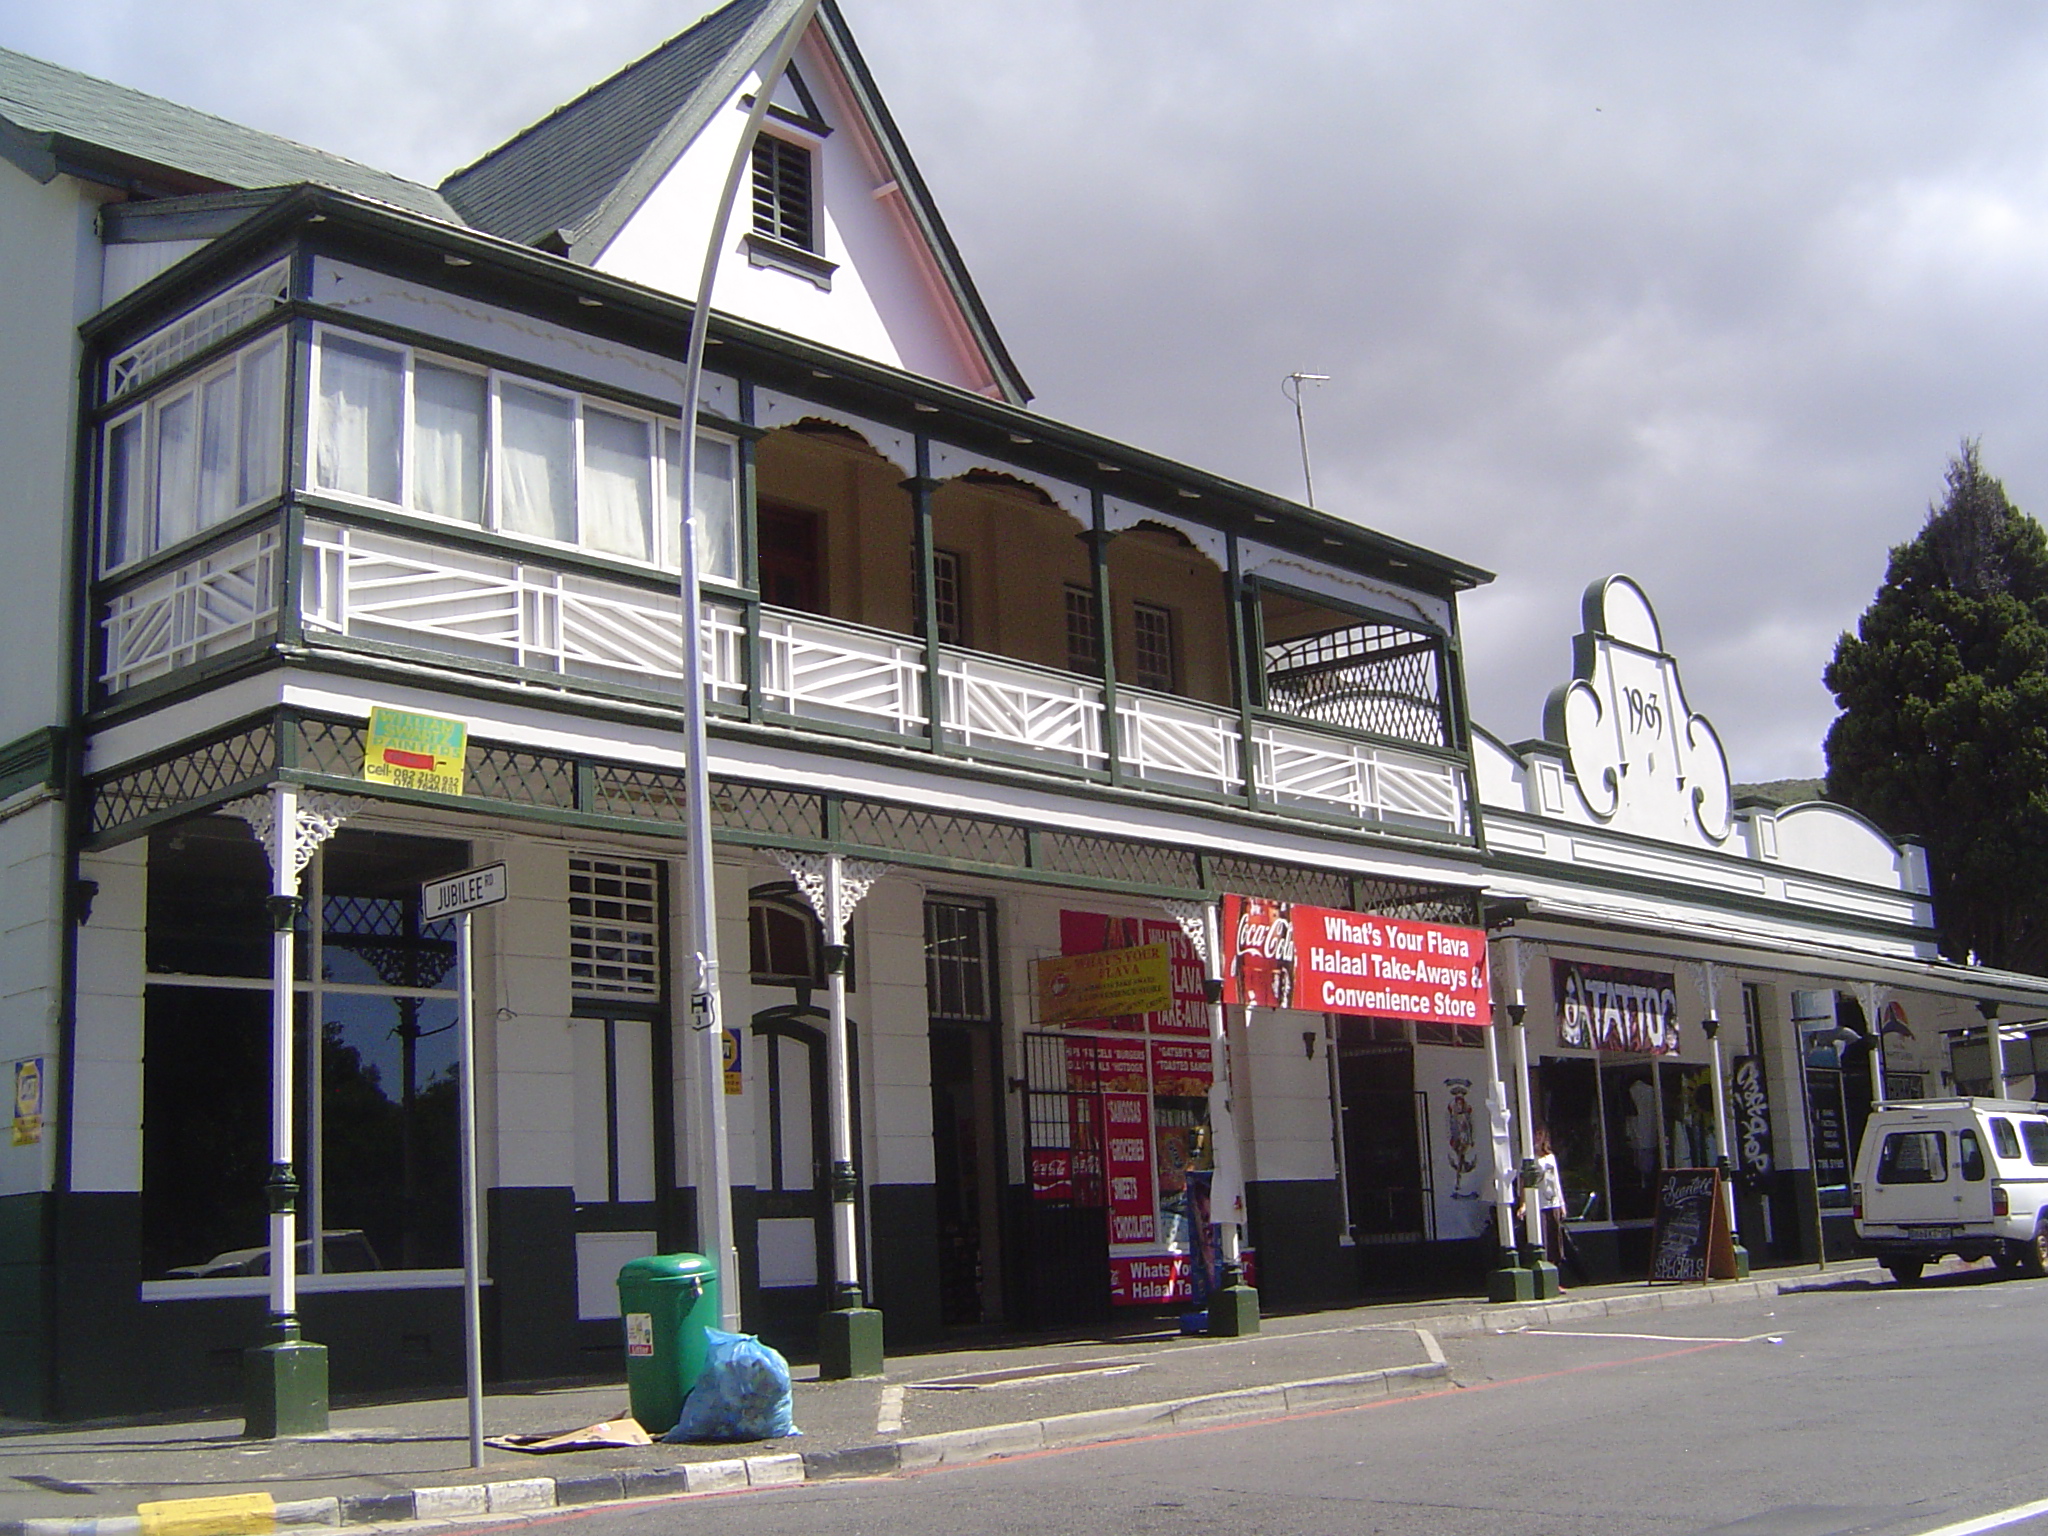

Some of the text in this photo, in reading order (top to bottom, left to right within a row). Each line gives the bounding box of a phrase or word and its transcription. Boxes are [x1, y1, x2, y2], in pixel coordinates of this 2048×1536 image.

[379, 710, 453, 733] WILLIAM
[372, 735, 461, 758] PAINTERS
[383, 725, 457, 746] SWARTZ
[394, 768, 415, 780] 082
[437, 873, 494, 911] JUBILEE RD
[1324, 915, 1469, 957] What's Your Flava
[1311, 947, 1367, 977] Halaal
[1371, 954, 1467, 992] Take-Aways
[1322, 980, 1476, 1018] Convenience Store
[1113, 1177, 1138, 1200] SWEETS
[1115, 1215, 1154, 1239] CHOCOLATES
[1130, 1262, 1169, 1279] Whats
[1132, 1281, 1172, 1299] Halaal
